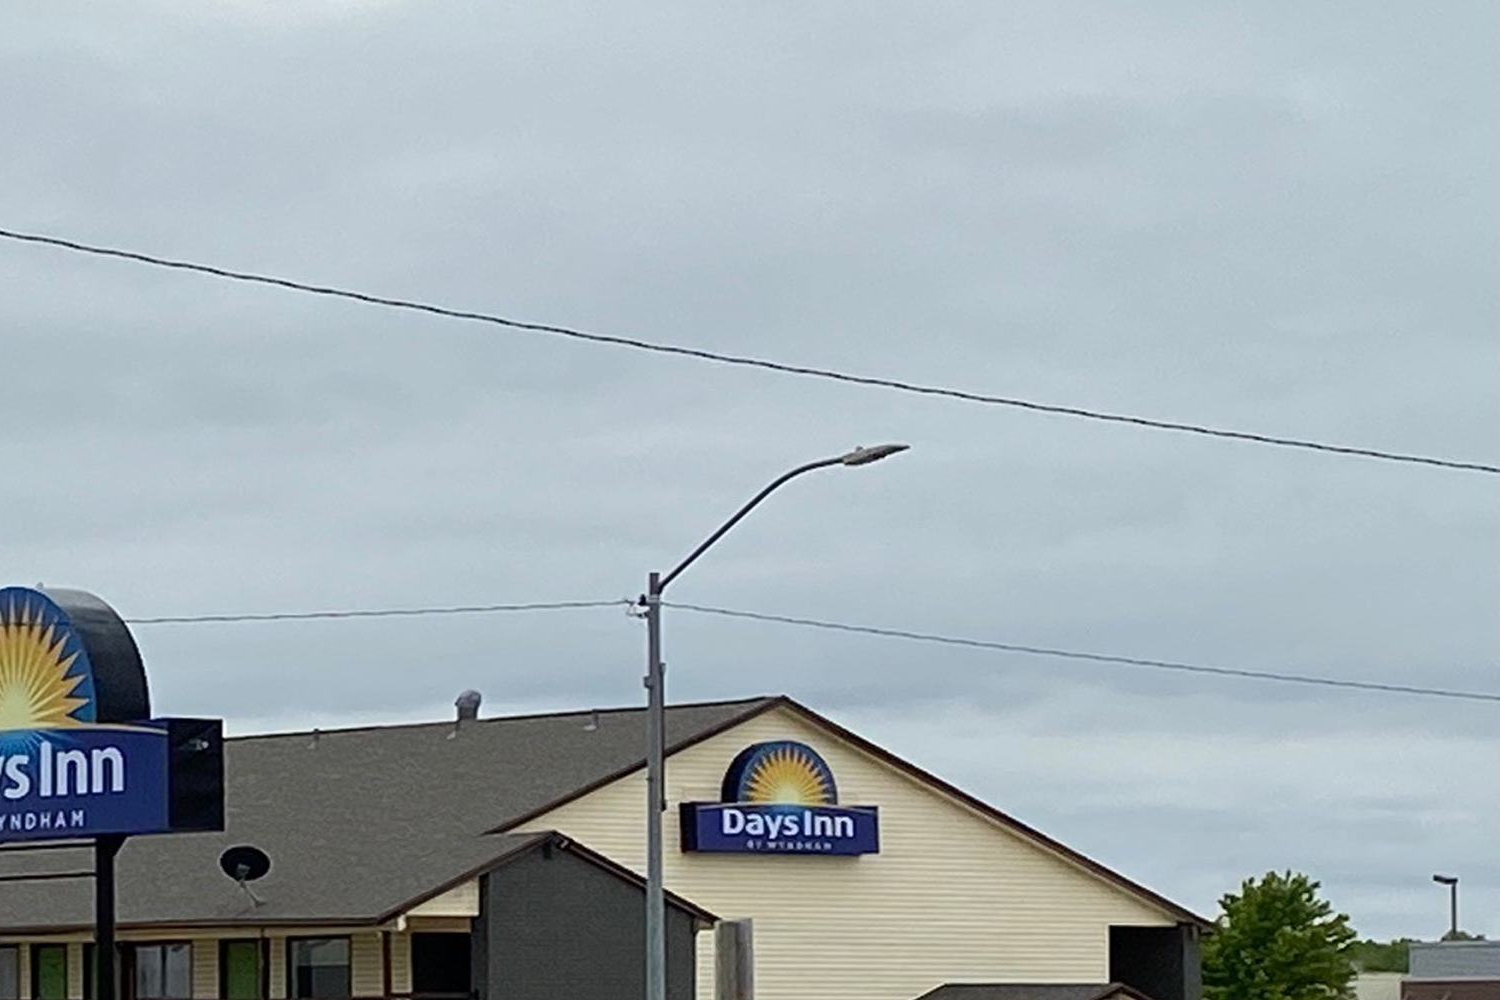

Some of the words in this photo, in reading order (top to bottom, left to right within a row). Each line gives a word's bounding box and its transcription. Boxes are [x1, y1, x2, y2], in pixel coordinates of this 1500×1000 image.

[39, 740, 125, 797] Inn
[722, 808, 800, 840] Days
[804, 810, 854, 838] Inn
